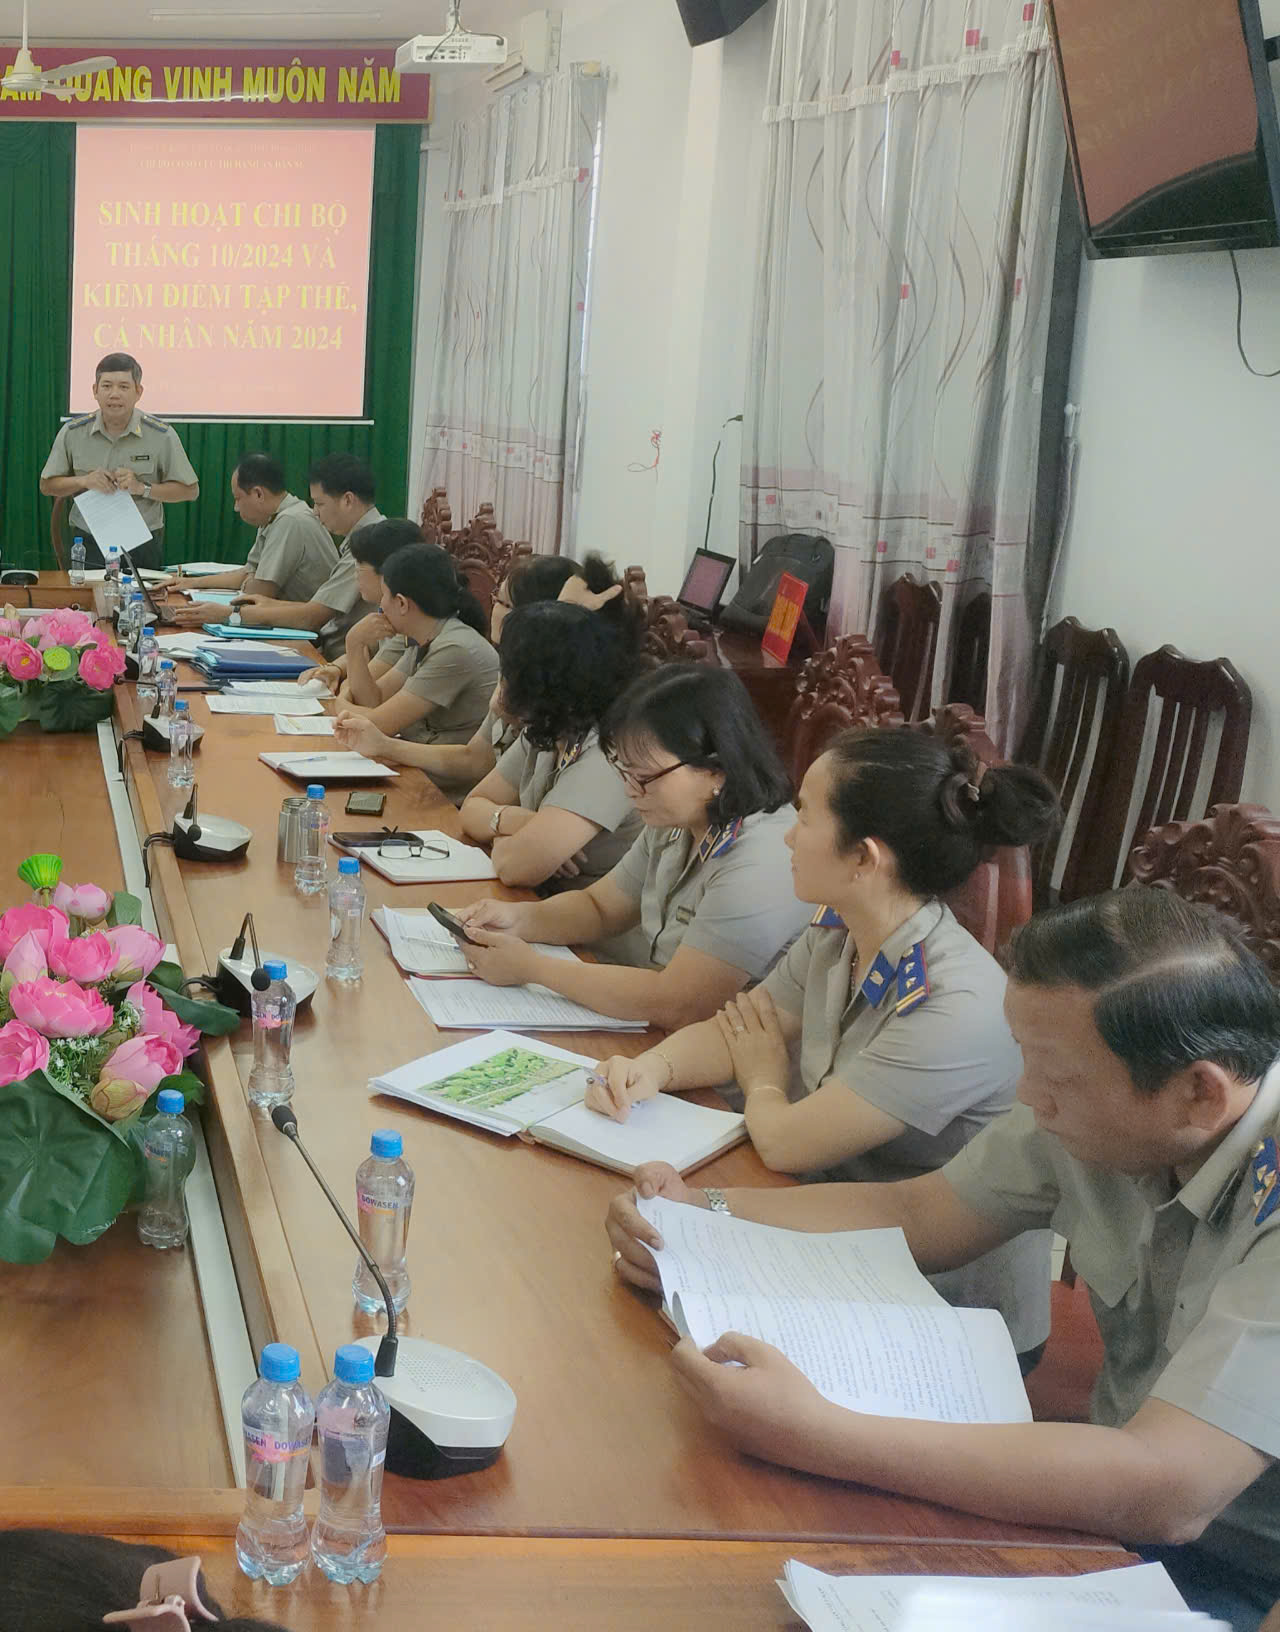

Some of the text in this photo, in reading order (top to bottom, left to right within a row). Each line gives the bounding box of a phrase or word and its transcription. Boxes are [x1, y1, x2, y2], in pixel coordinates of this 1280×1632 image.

[164, 66, 232, 102] VINH
[243, 57, 325, 103] MUÔN
[338, 57, 400, 103] NĂM
[98, 200, 348, 235] SINH HOẠT CHI BỘ
[105, 233, 337, 269] THÁNG 10/2024 VÀ
[94, 316, 343, 350] CÁ NHÂN NĂM 2024
